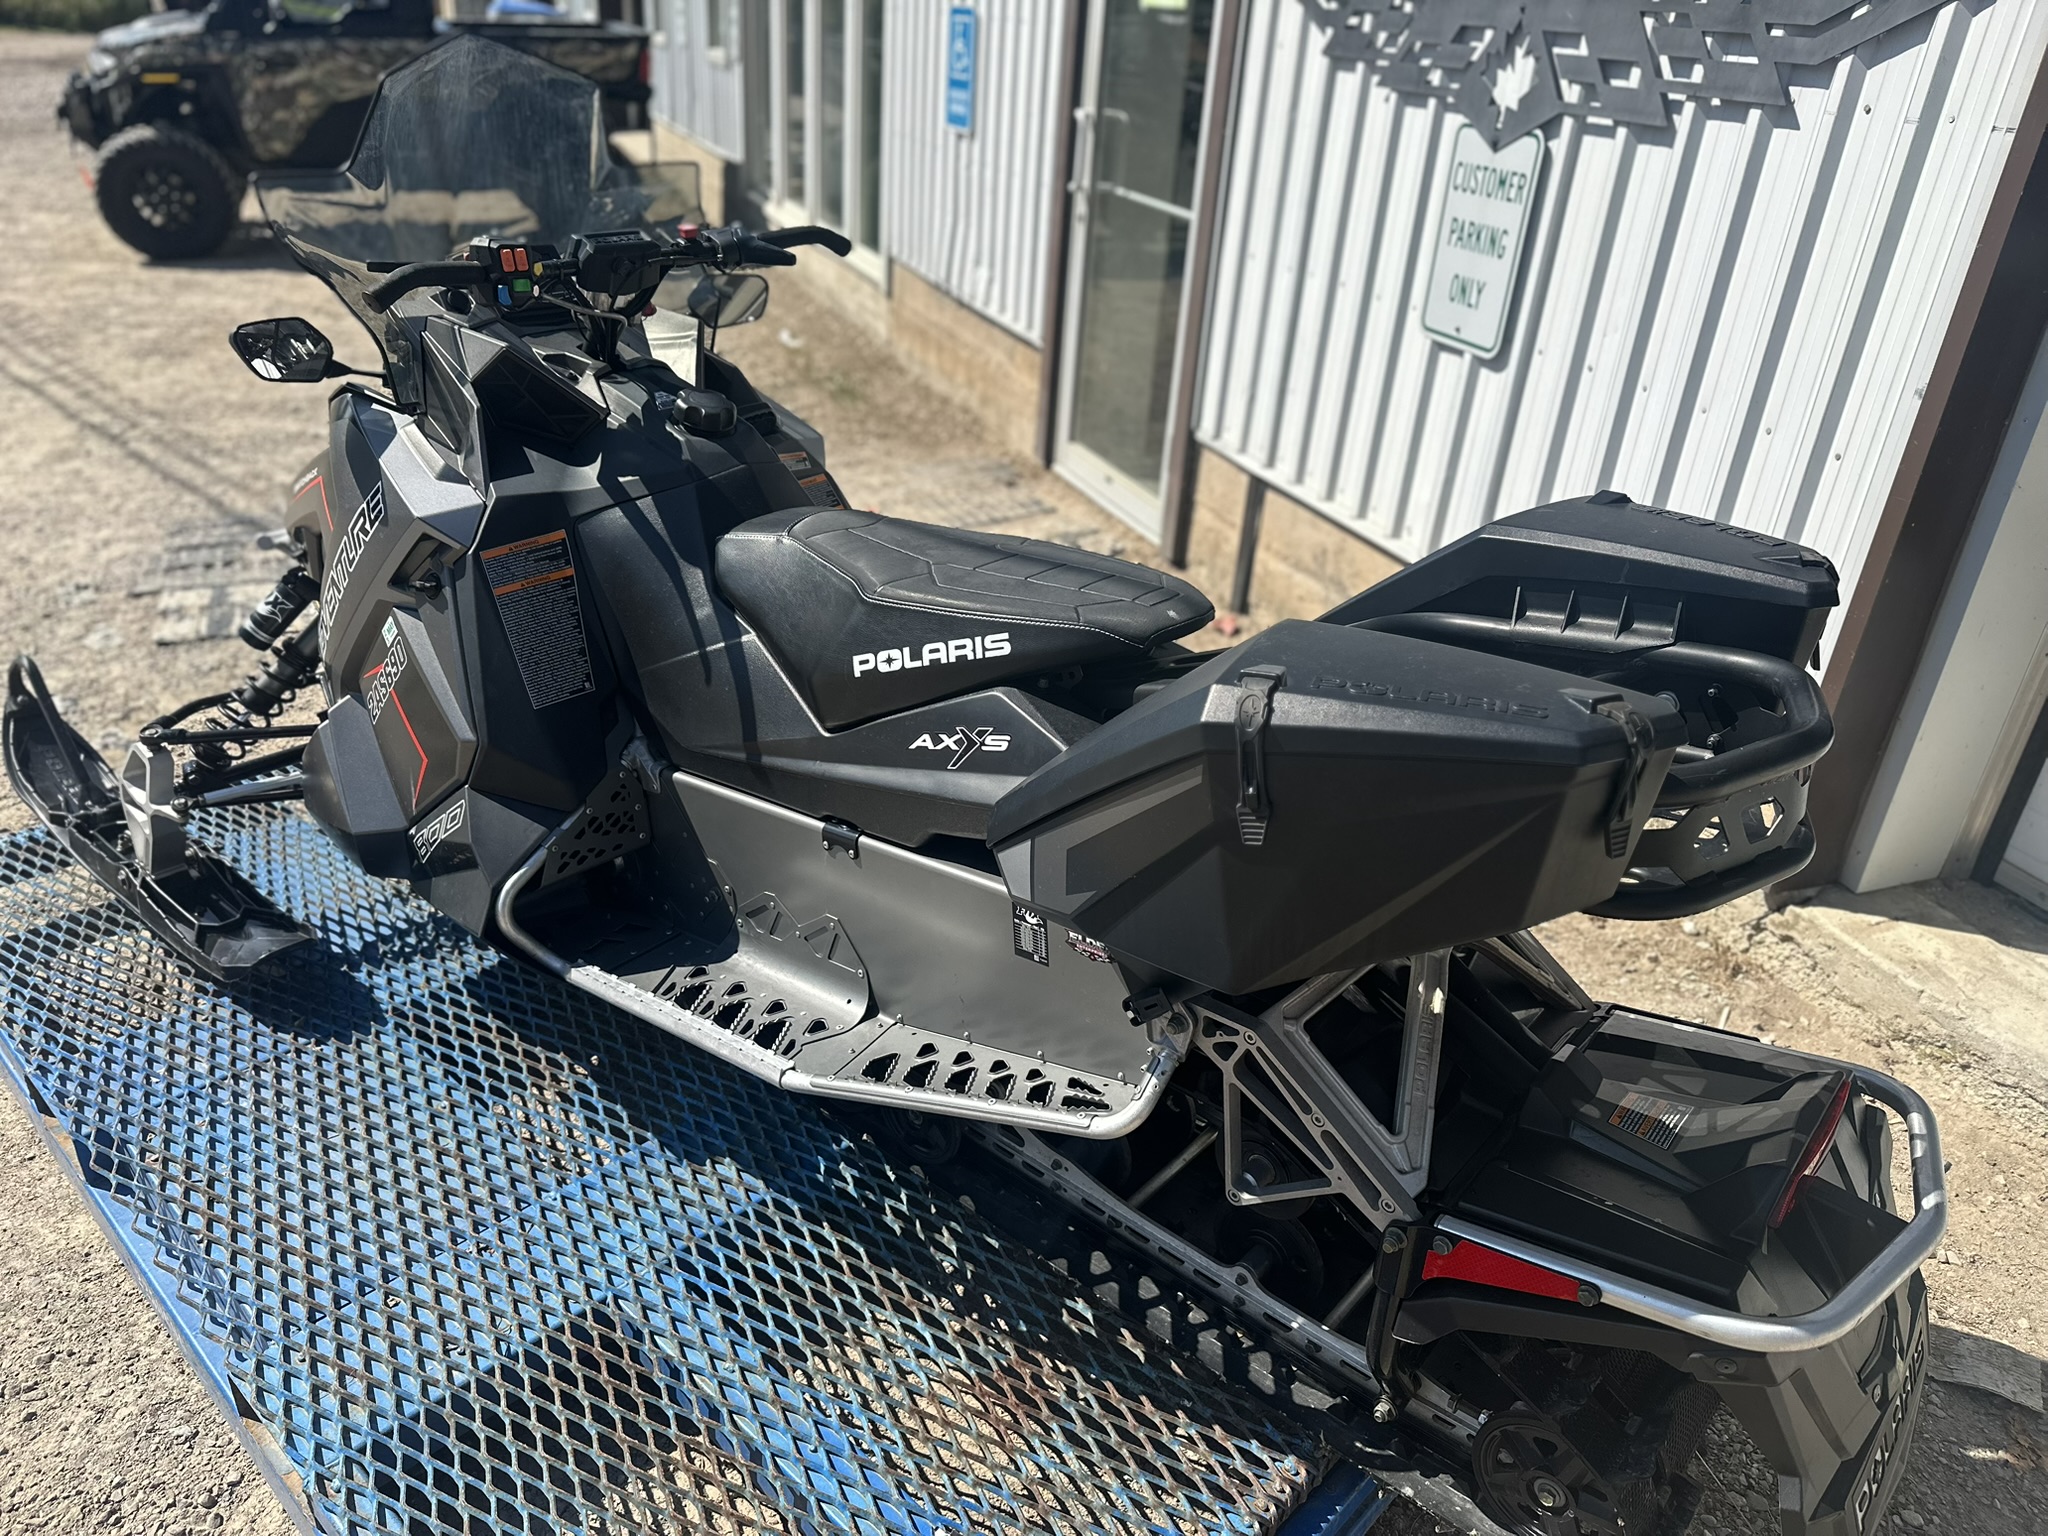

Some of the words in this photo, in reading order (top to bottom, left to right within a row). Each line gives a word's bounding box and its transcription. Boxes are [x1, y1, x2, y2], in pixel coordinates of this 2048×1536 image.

[1453, 161, 1527, 205] CUSTOMER
[1448, 217, 1508, 260] PARKING
[1449, 273, 1486, 311] ONLY
[852, 632, 1012, 678] POLARIS
[1310, 675, 1550, 720] POLARIS
[908, 726, 1012, 770] AXYS
[412, 799, 466, 864] 800
[1856, 1327, 1925, 1533] POLARIS
